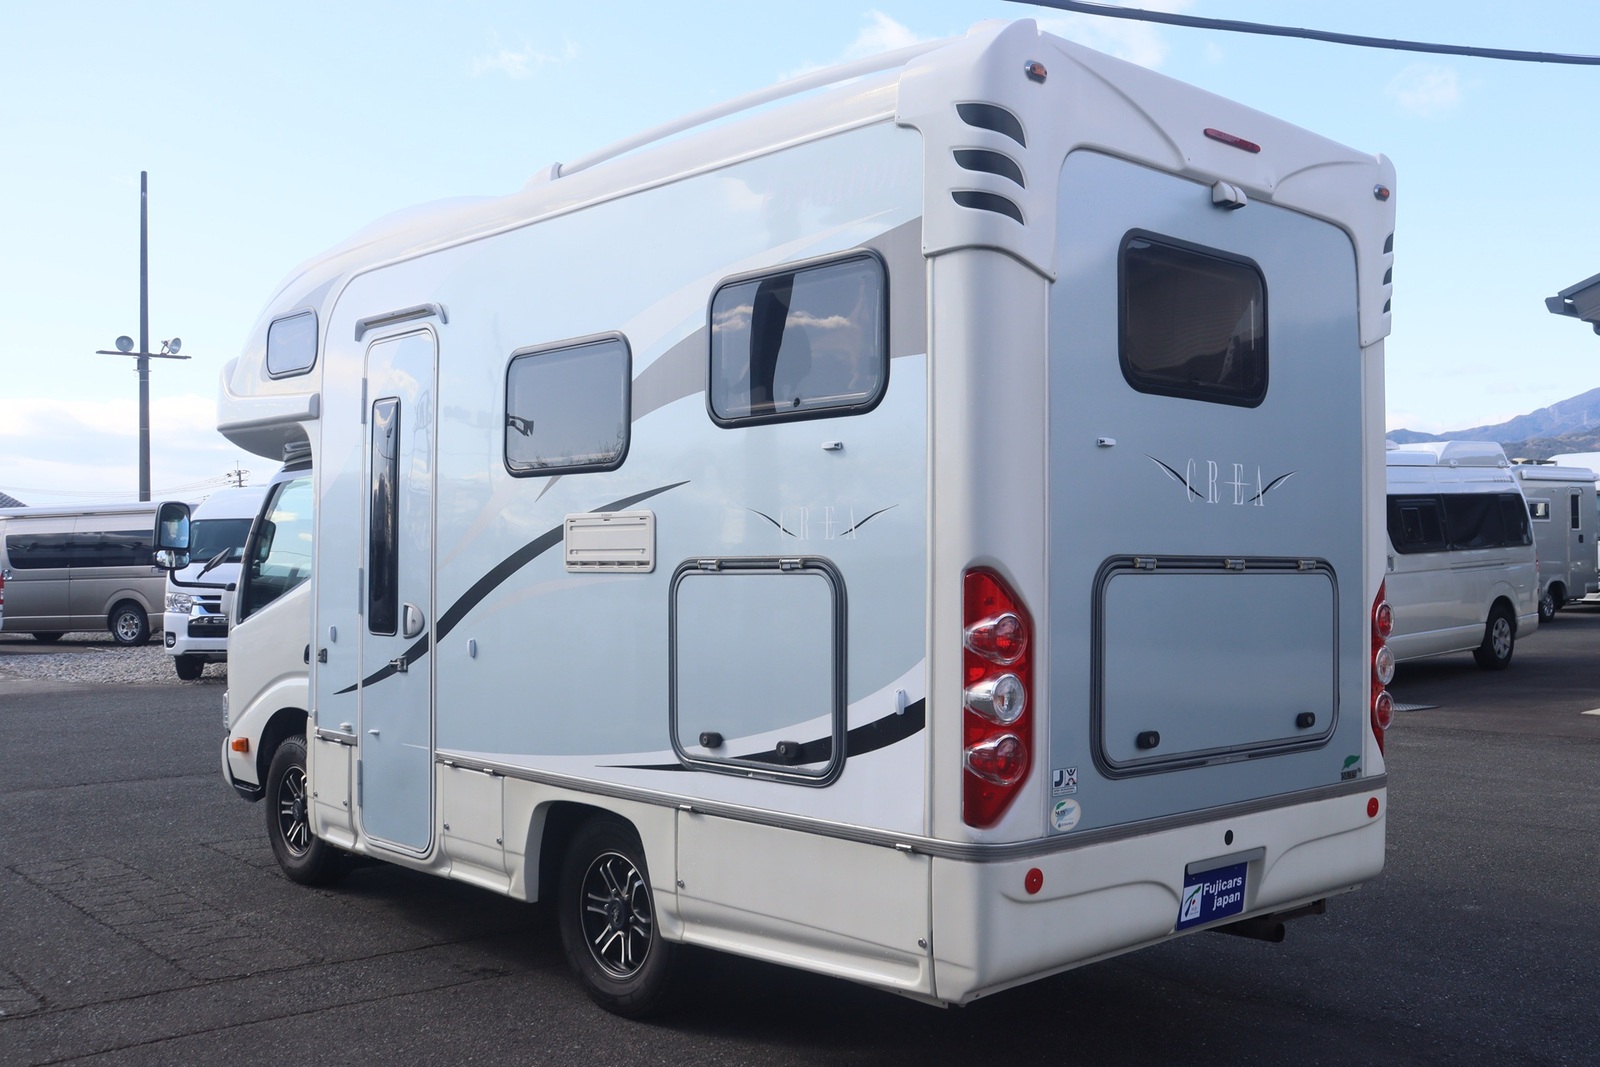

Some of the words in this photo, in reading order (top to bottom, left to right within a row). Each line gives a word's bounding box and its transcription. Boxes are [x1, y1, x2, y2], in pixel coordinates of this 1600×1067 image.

[1186, 457, 1265, 507] CREA
[779, 506, 857, 541] CREA
[1203, 876, 1243, 896] Fujicars
[1212, 891, 1241, 911] japan
